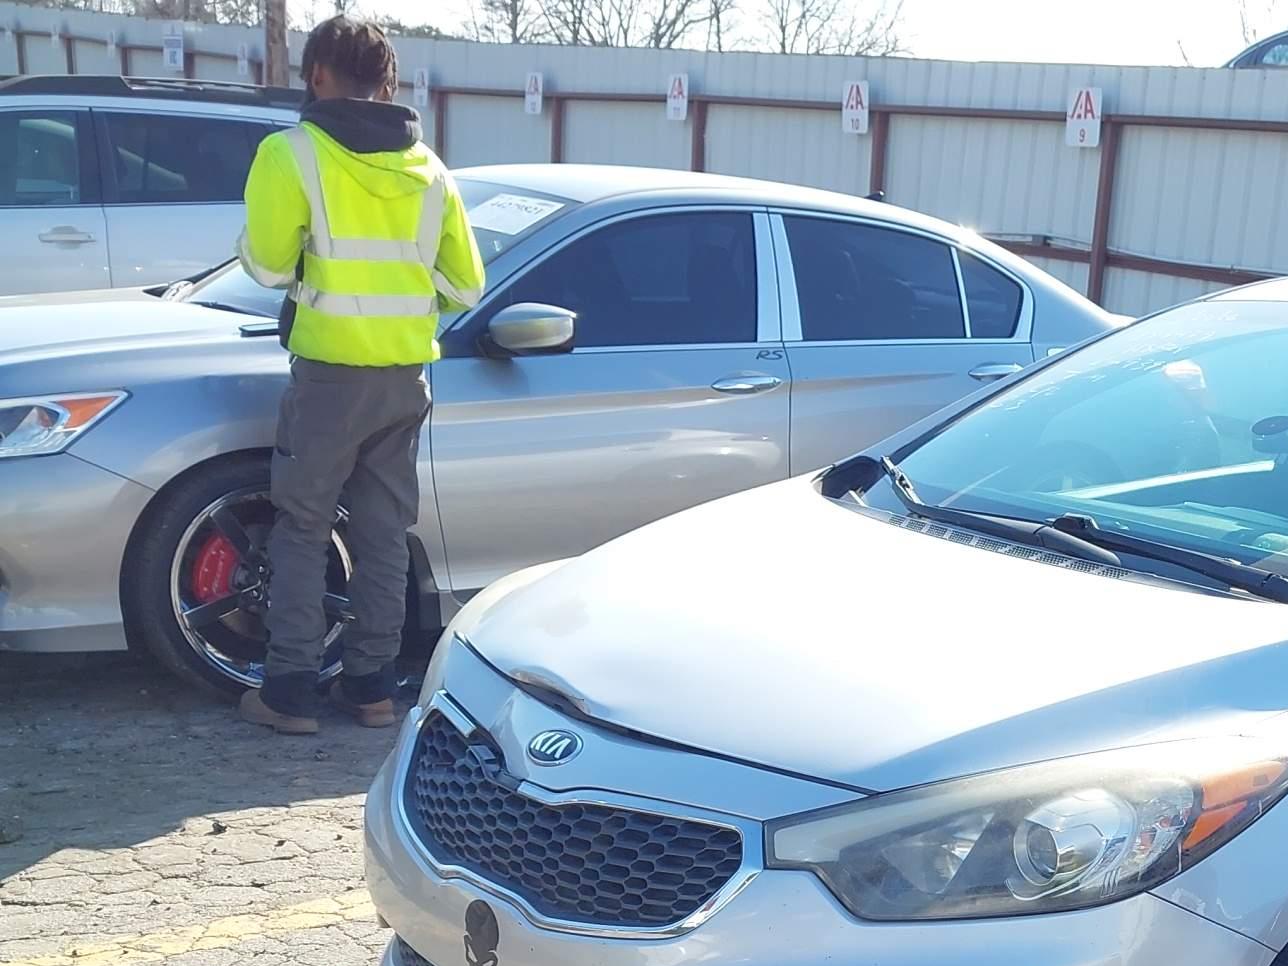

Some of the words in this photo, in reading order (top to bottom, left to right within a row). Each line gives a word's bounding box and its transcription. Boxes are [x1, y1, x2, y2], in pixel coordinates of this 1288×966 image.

[850, 118, 860, 130] 10
[1078, 128, 1086, 143] 9
[756, 350, 783, 360] RS
[530, 732, 571, 758] KIA
